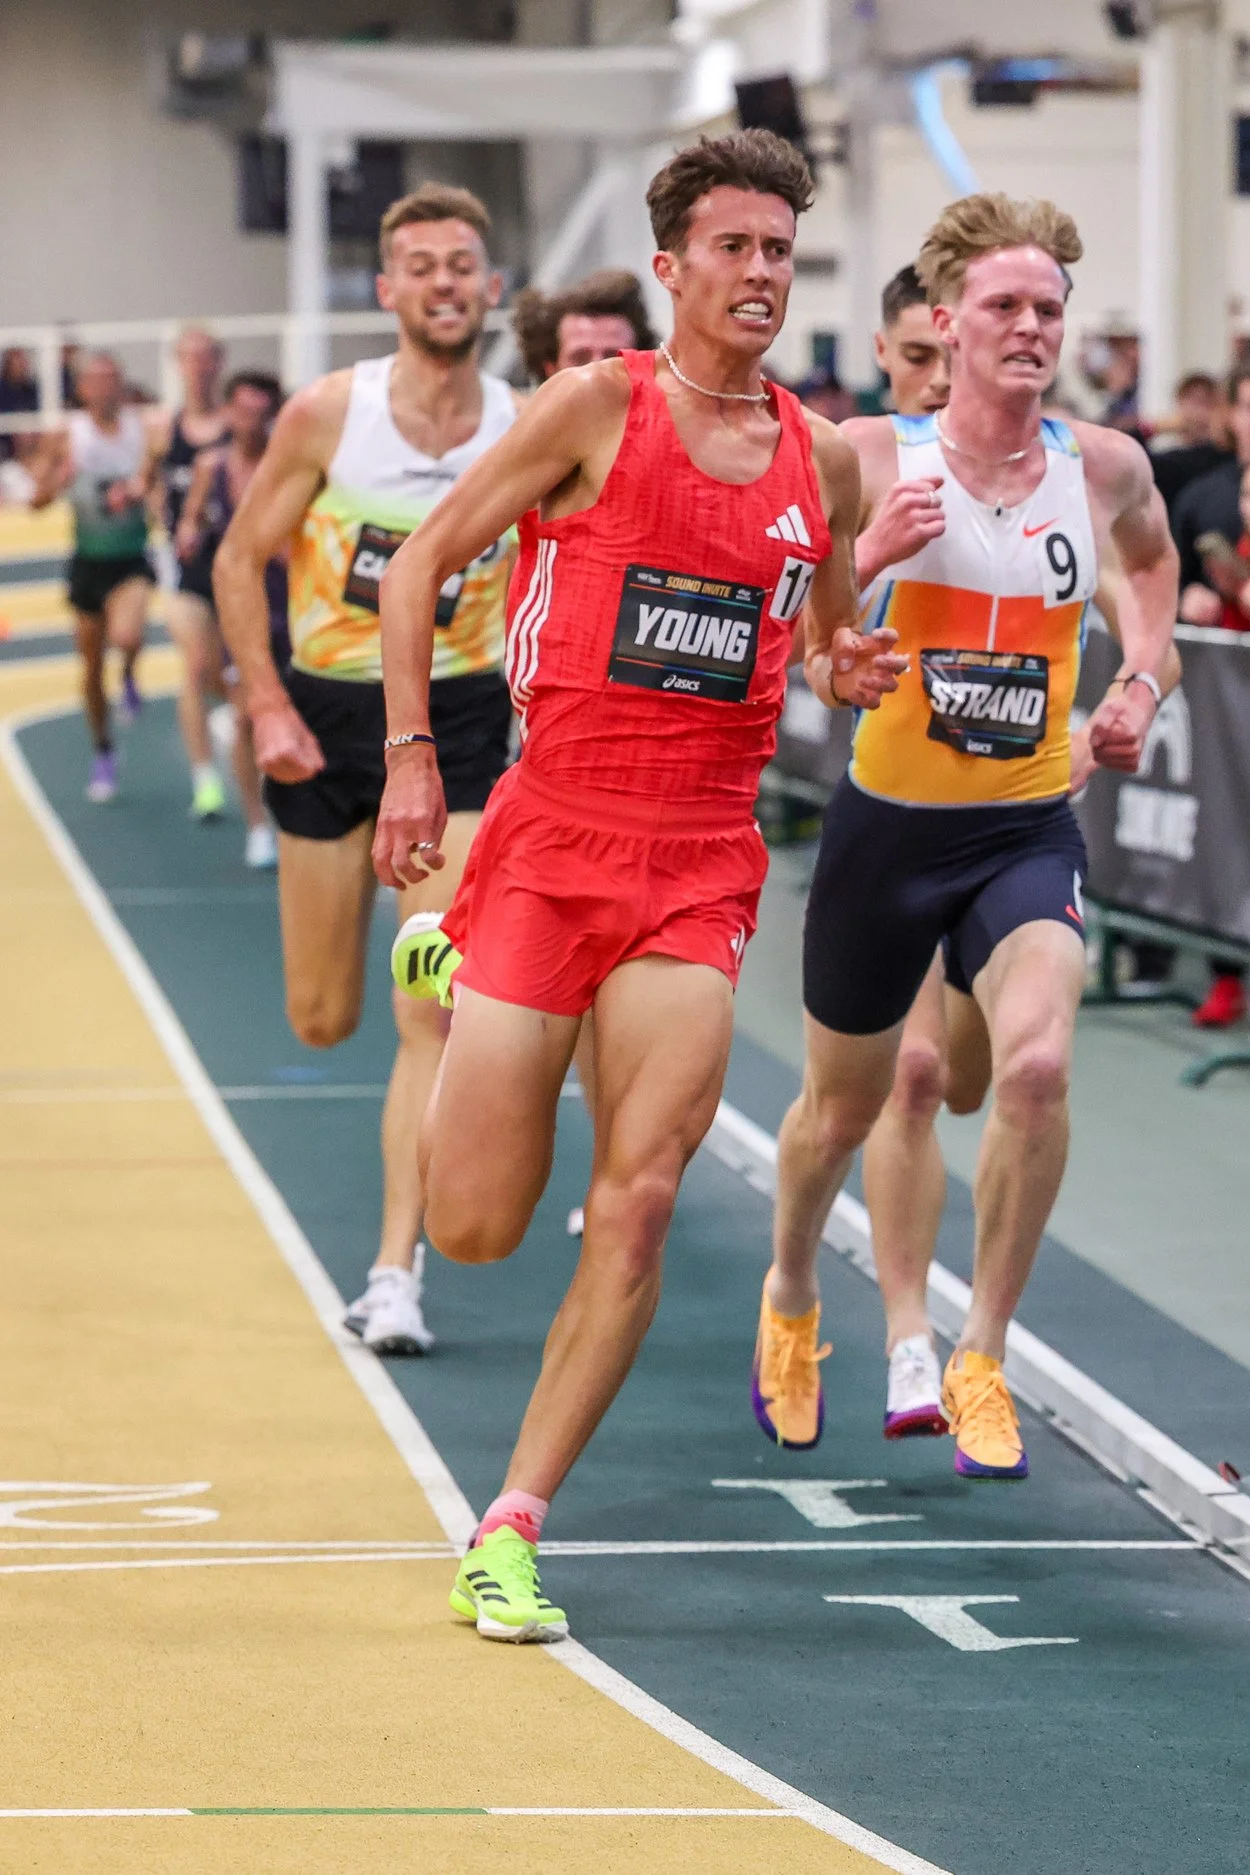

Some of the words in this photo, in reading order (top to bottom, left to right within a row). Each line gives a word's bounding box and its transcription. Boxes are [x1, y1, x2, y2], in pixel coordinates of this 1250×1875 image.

[665, 575, 702, 593] SOUND
[1045, 532, 1078, 601] 9
[634, 603, 752, 662] YOUNG
[929, 679, 1046, 726] STRAND
[0, 1481, 220, 1529] 2
